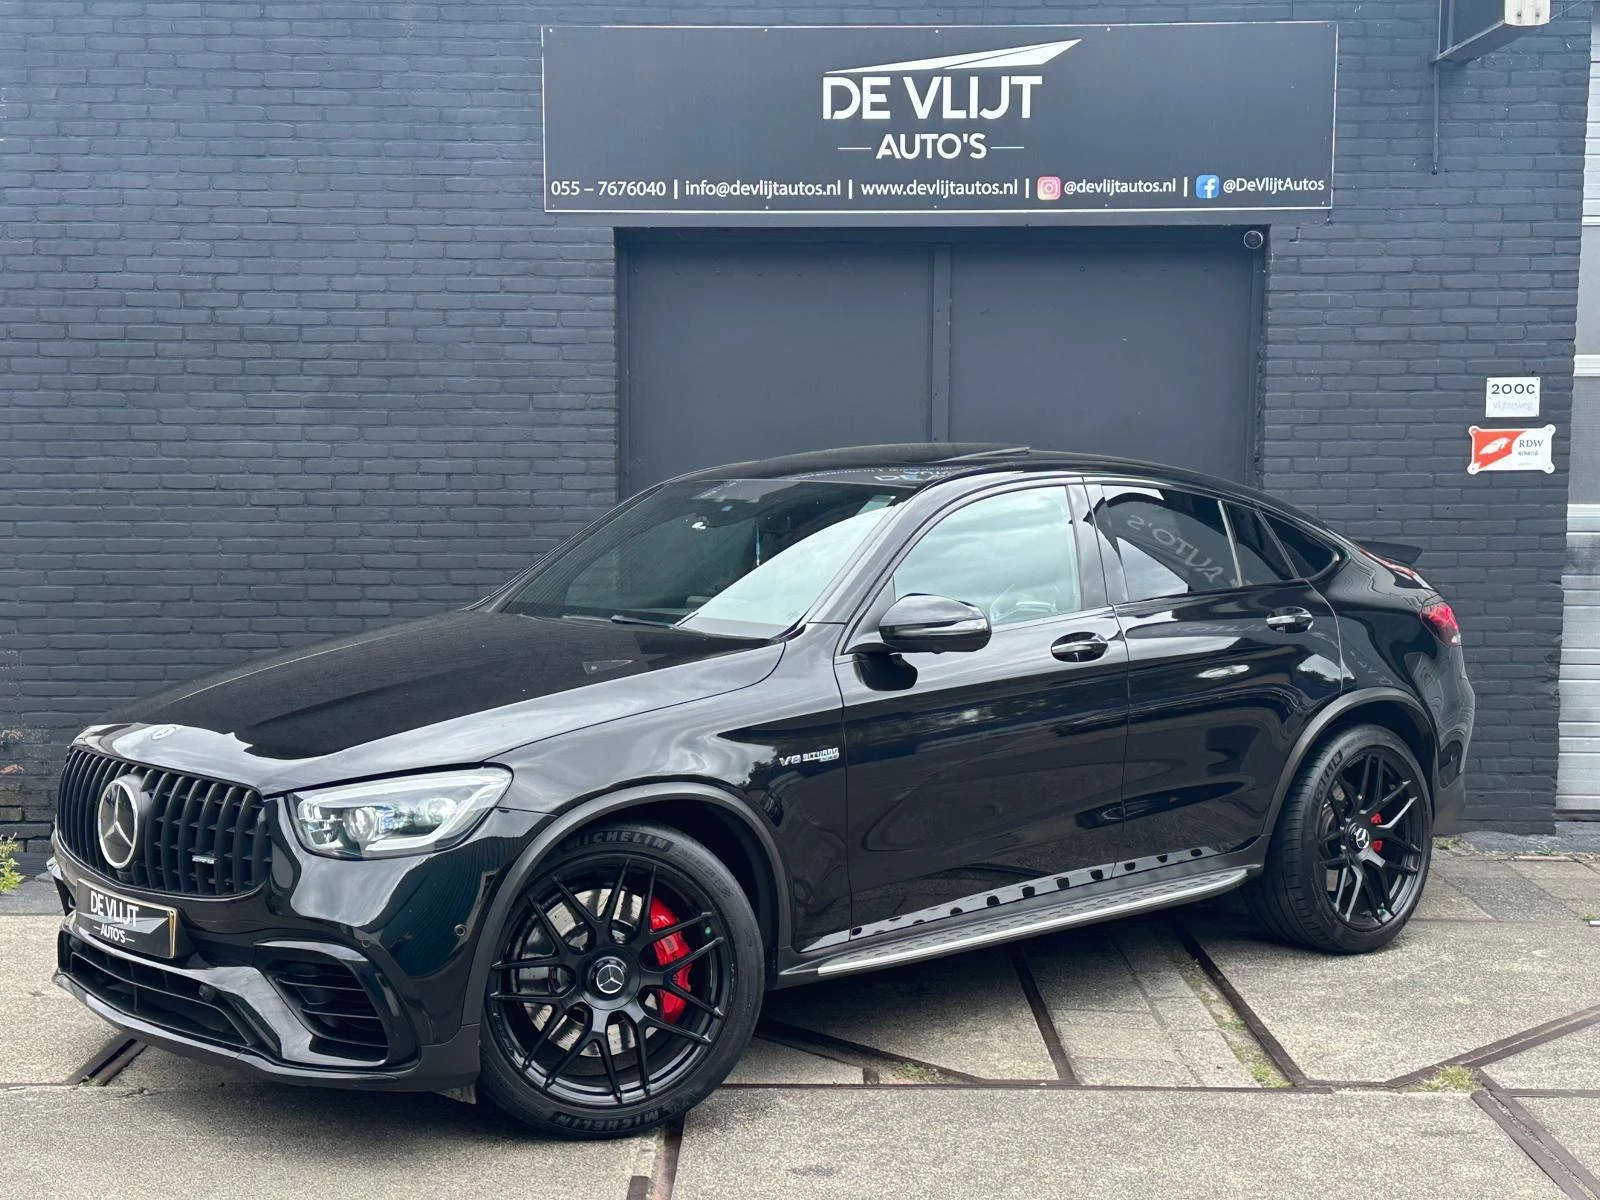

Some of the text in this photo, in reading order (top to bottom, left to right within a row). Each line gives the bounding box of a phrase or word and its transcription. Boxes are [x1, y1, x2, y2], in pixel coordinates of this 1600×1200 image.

[823, 75, 1043, 120] DE VLIJT
[875, 132, 987, 160] AUTO'S
[550, 180, 581, 196] 055
[597, 180, 666, 197] 7676040
[685, 179, 841, 200] info@devlijtautos.nl
[860, 178, 1018, 200] www.devlijtautos.nl
[1063, 177, 1176, 197] @devlijtautos.nl
[1223, 176, 1325, 194] @DeVlijtAutos
[1519, 439, 1544, 448] RDW
[566, 830, 669, 850] MICHELIN
[90, 890, 139, 927] DE VLIJT
[100, 923, 126, 944] AUTO'S
[556, 1110, 660, 1131] MICHELIN
